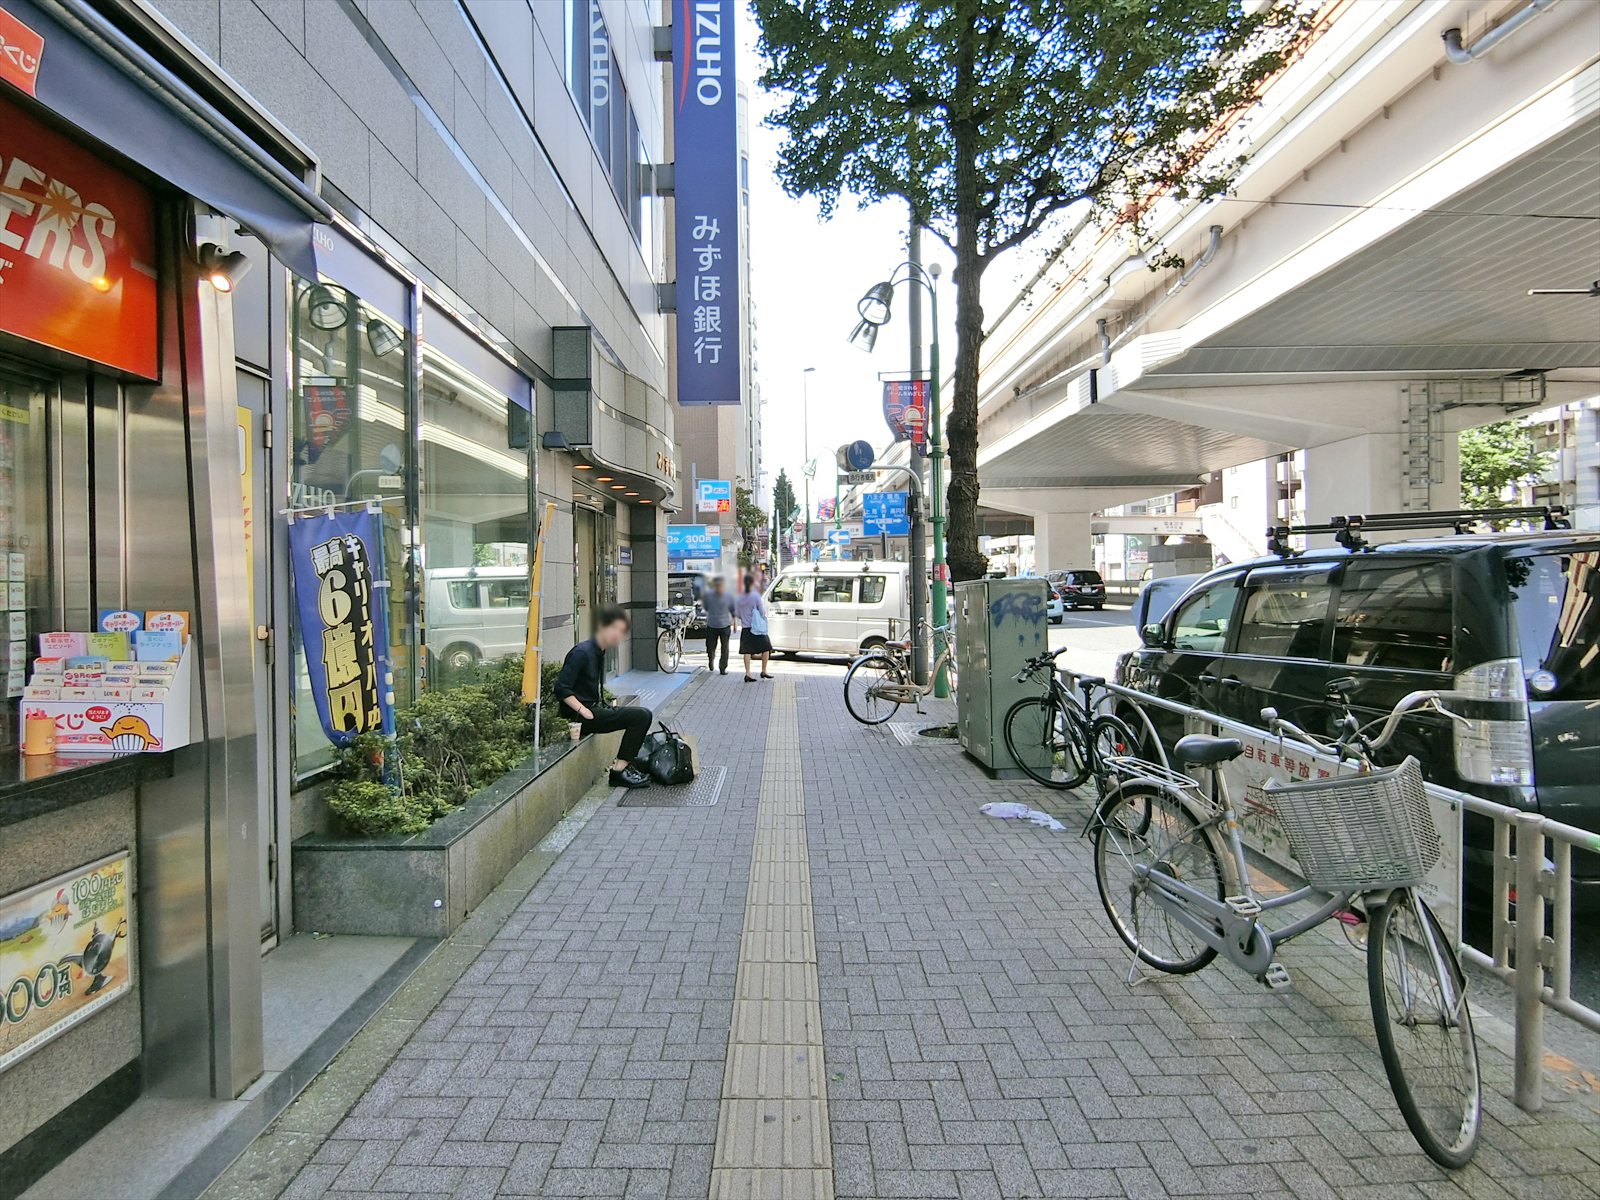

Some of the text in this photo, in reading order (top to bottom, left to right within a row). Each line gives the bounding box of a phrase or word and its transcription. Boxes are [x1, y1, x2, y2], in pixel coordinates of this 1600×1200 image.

[0, 156, 117, 285] ERS
[691, 214, 722, 364] みずほ銀行
[701, 484, 712, 500] P
[311, 538, 345, 574] 最高
